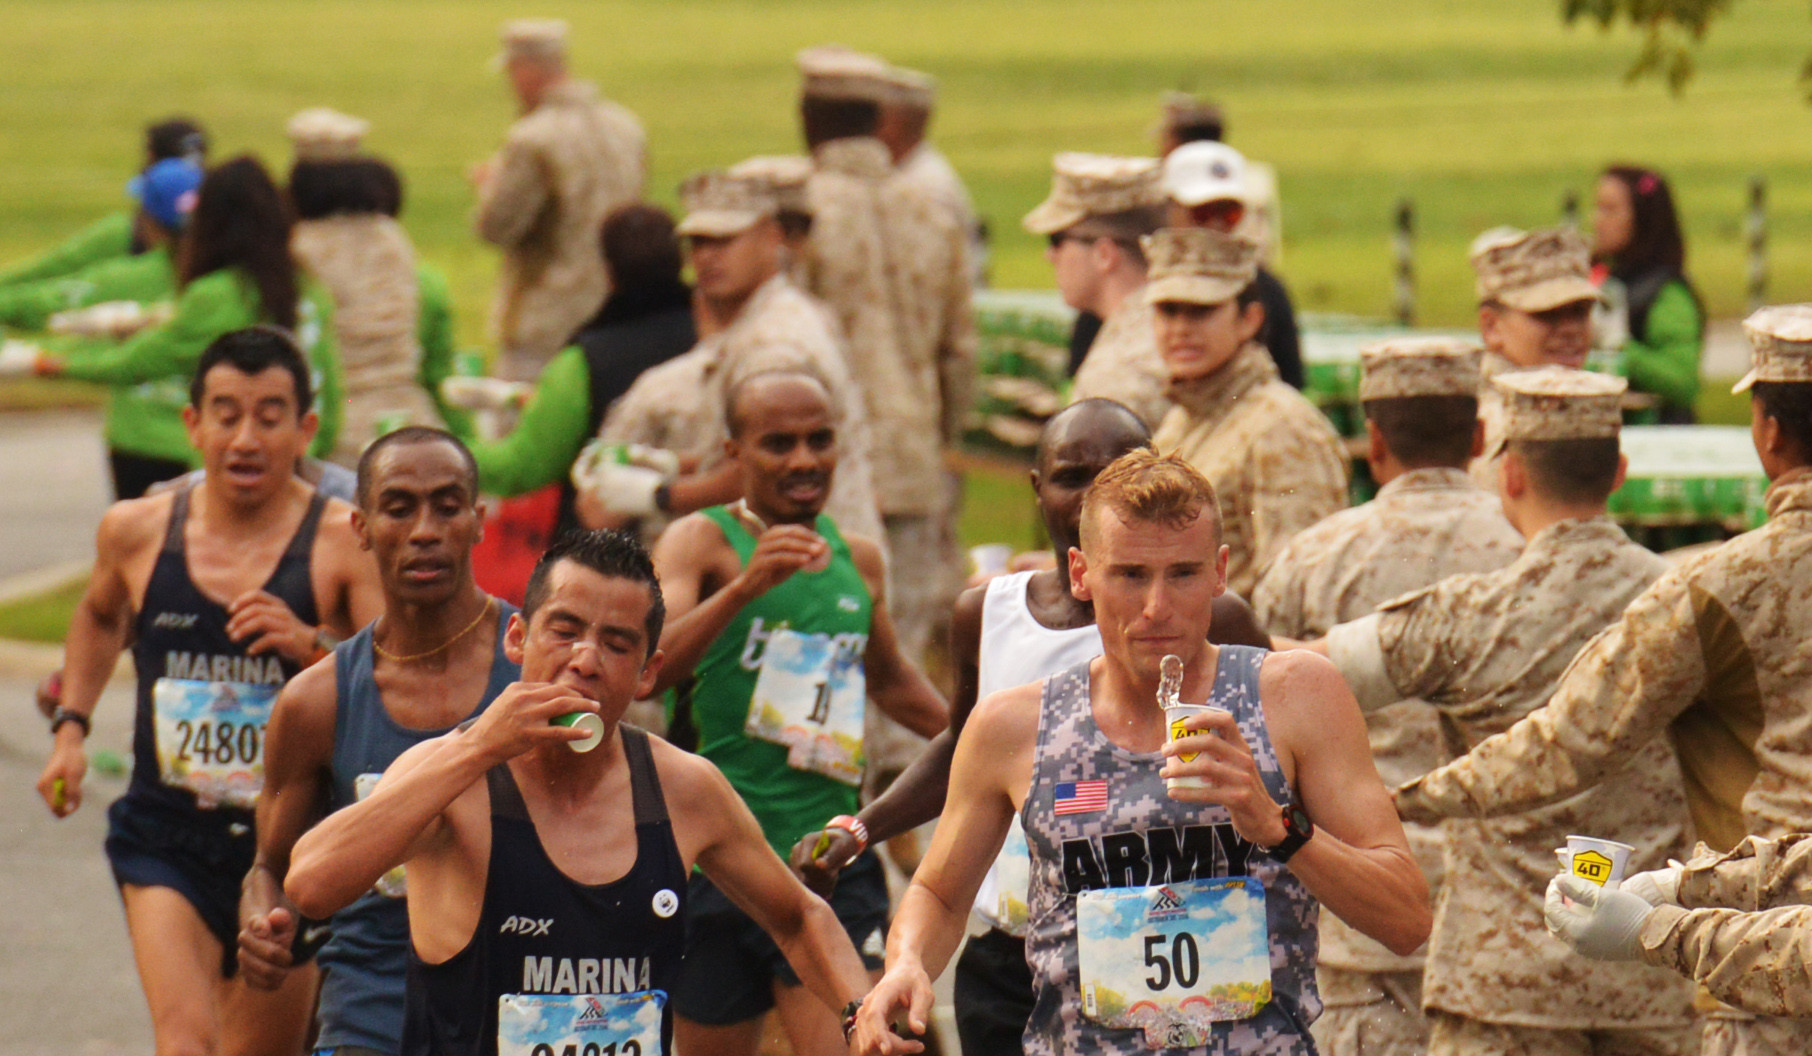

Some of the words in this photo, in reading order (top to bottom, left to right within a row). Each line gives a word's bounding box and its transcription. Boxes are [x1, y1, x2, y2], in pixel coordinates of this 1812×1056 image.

[166, 651, 284, 682] MARINA
[176, 719, 267, 764] 2480
[1061, 823, 1257, 893] ARMY
[501, 915, 554, 937] ADX
[523, 955, 650, 994] MARINA
[1144, 931, 1200, 991] 50
